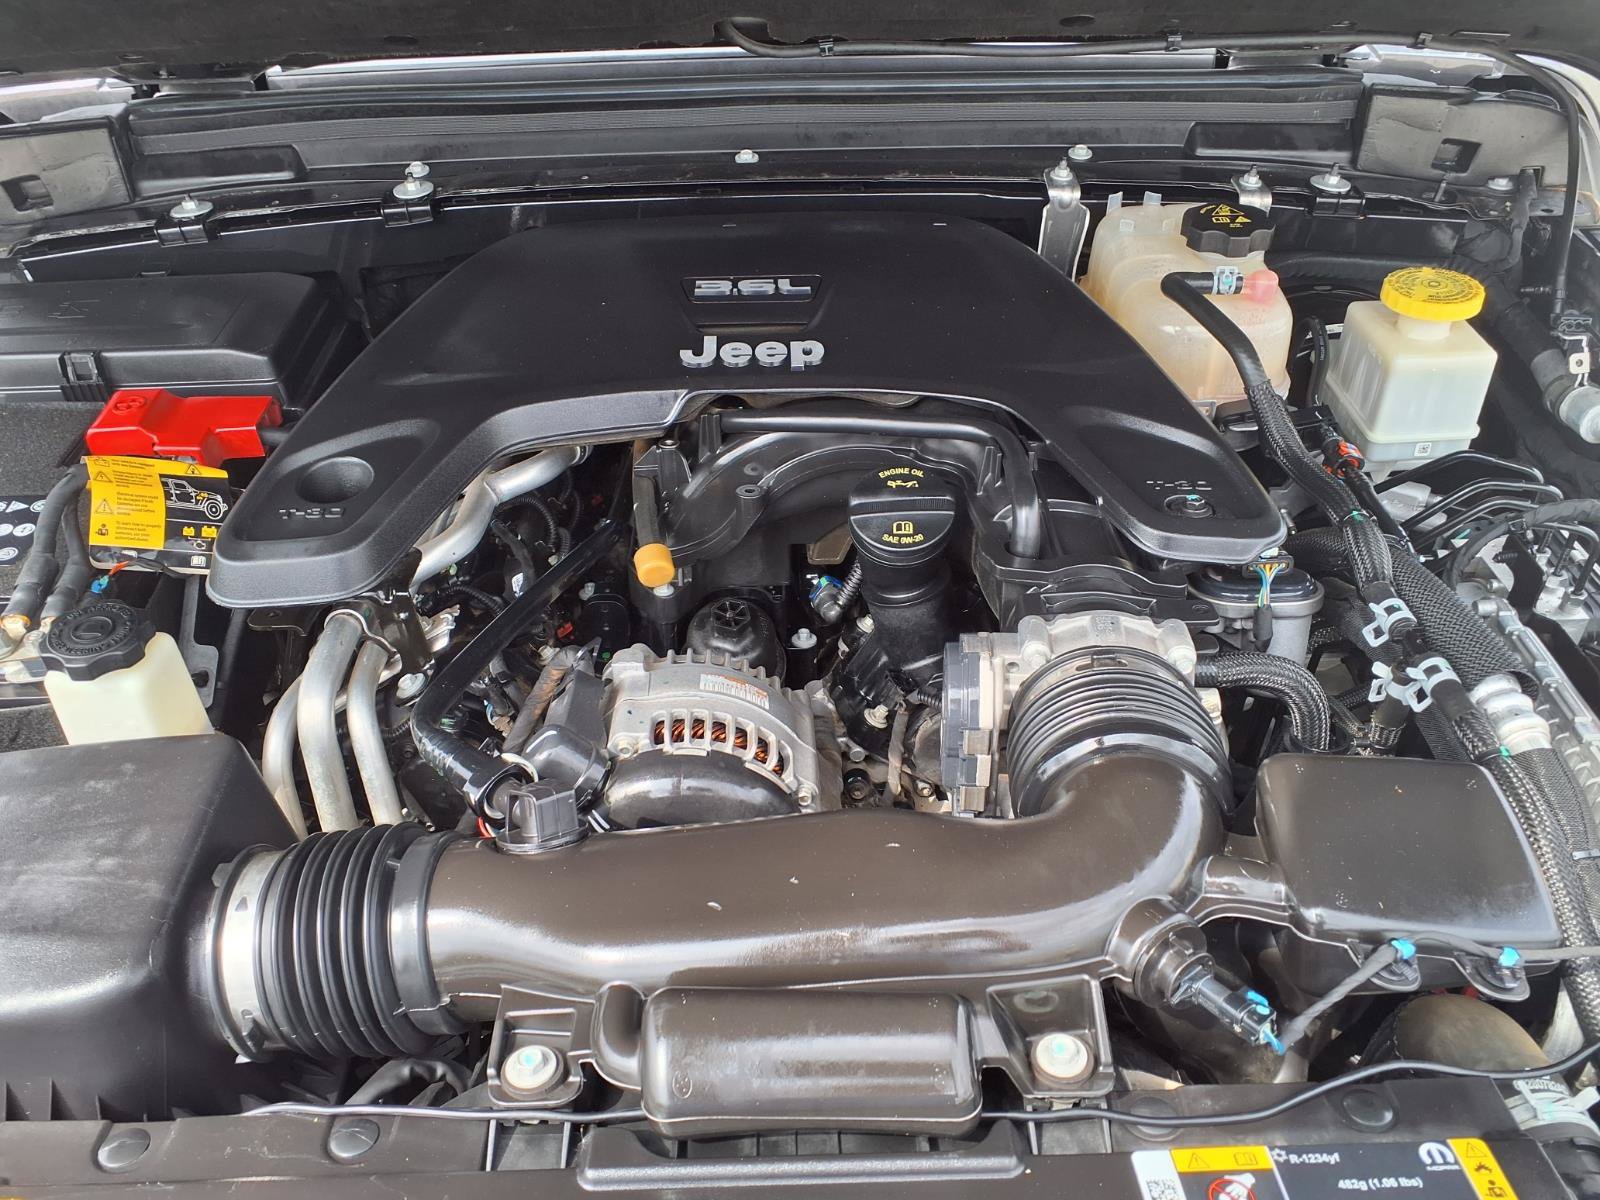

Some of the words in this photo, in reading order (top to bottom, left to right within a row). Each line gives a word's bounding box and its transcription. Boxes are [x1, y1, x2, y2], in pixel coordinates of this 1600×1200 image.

[694, 278, 812, 297] 3.6L
[679, 335, 825, 372] Jeep
[878, 467, 911, 479] ENGINE
[911, 468, 925, 478] OIL
[882, 533, 899, 543] SAE
[900, 533, 924, 544] 0W-20
[1288, 1152, 1340, 1165] R-1234yf
[1398, 1176, 1424, 1189] lbs)
